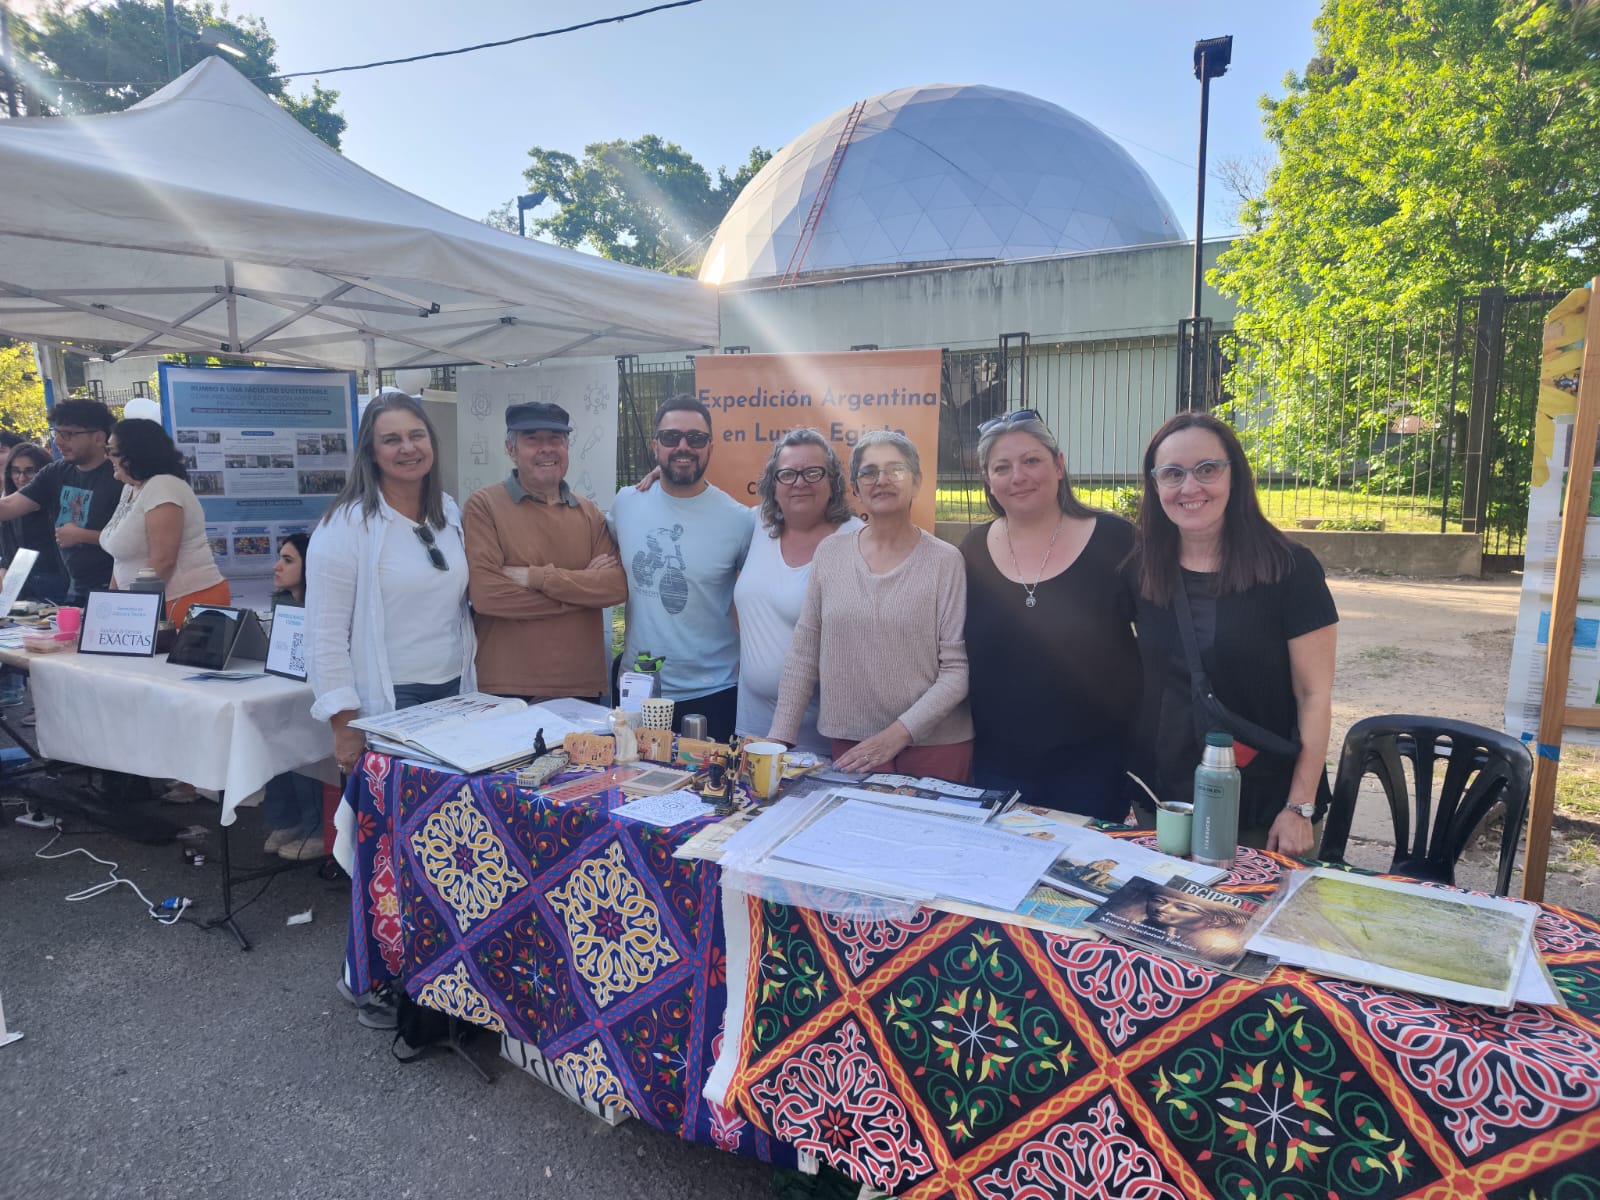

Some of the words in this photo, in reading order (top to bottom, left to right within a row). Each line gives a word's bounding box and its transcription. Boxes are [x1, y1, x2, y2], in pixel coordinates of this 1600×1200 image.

[698, 387, 812, 412] Expedición
[821, 387, 937, 412] Argentina
[723, 429, 746, 442] en
[99, 633, 151, 647] EXACTAS
[1100, 916, 1127, 928] Museo
[1127, 926, 1165, 940] Nacional
